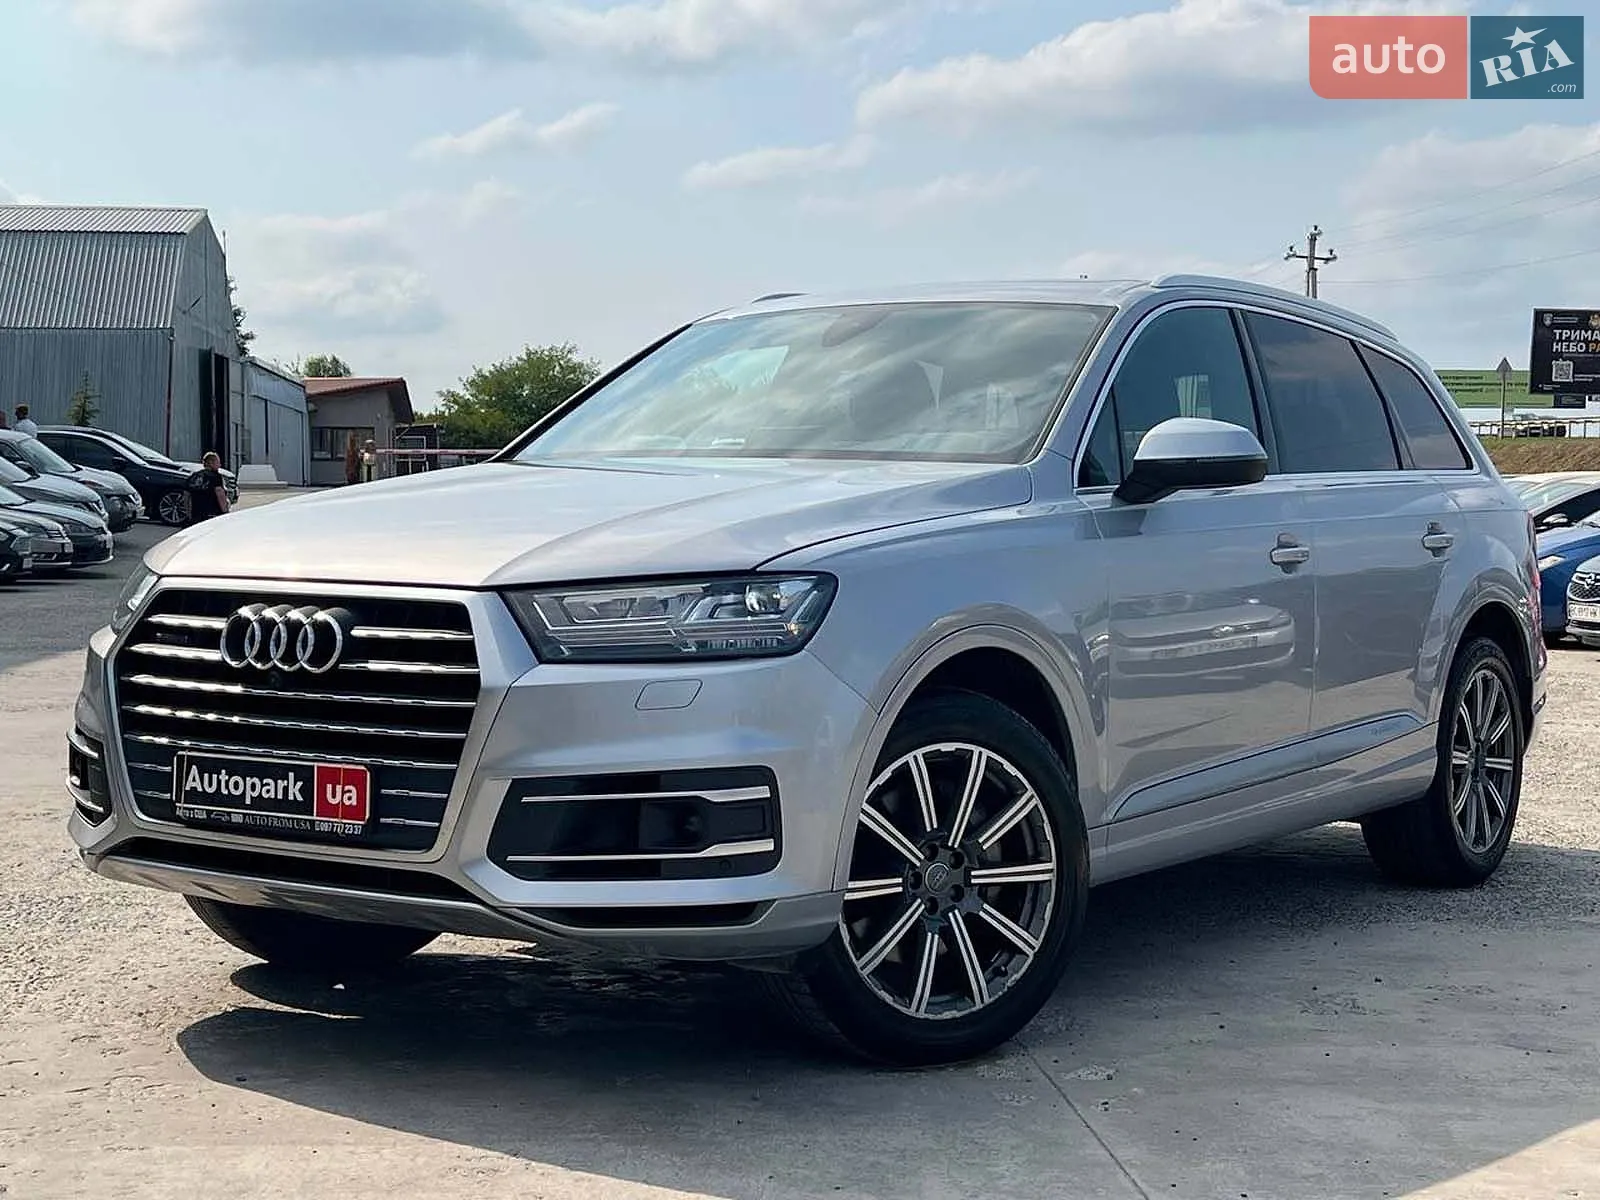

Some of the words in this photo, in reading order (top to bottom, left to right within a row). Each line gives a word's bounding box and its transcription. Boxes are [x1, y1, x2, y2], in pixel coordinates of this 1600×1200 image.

[1552, 342, 1586, 352] НЕБО
[185, 764, 303, 804] Autopark
[326, 783, 357, 806] ua
[244, 815, 267, 826] AUTO
